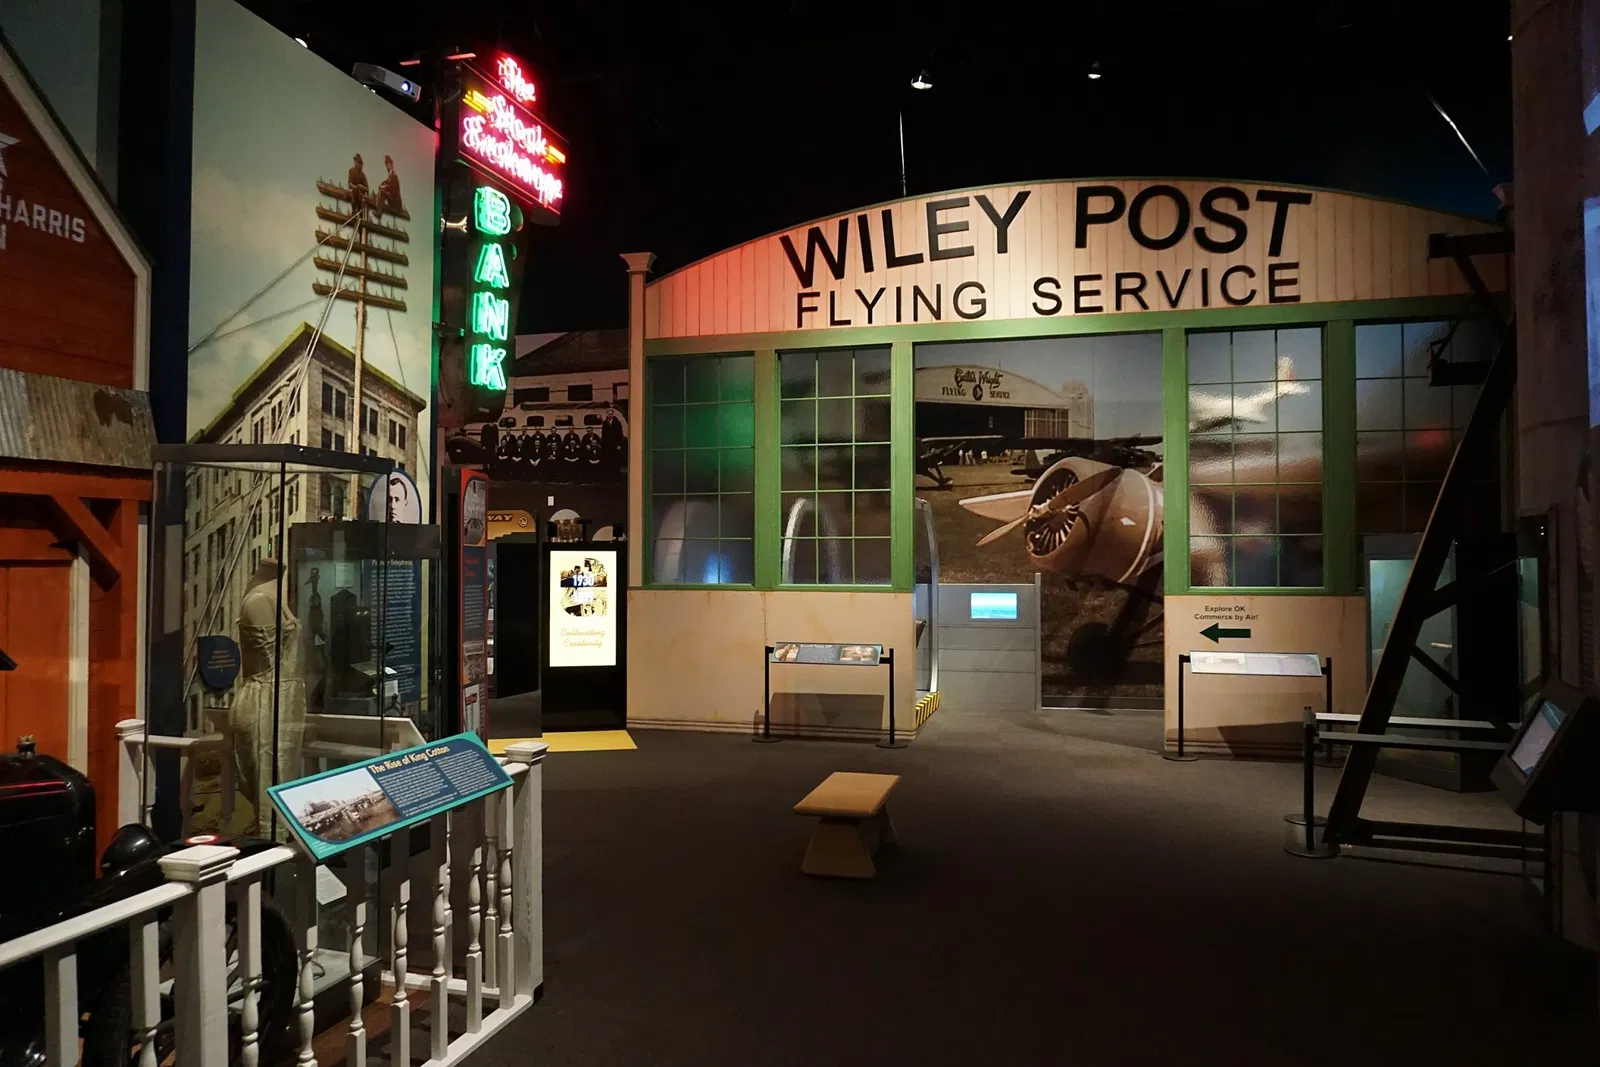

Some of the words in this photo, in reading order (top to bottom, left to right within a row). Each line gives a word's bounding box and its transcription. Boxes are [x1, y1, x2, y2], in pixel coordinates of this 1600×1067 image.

[497, 57, 536, 102] The
[0, 194, 86, 243] HARRIS
[779, 190, 1032, 289] WILEY
[1074, 184, 1313, 258] POST
[471, 186, 511, 390] BANK
[797, 281, 987, 328] FLYING
[1032, 261, 1301, 316] SERVICE
[941, 386, 967, 397] FLYING
[573, 574, 594, 586] 1930
[1204, 605, 1232, 613] Explore
[1234, 613, 1244, 621] by
[368, 764, 386, 774] The
[384, 760, 403, 770] Rise
[402, 755, 411, 765] of
[409, 752, 429, 761] King
[425, 746, 451, 757] Cotton
